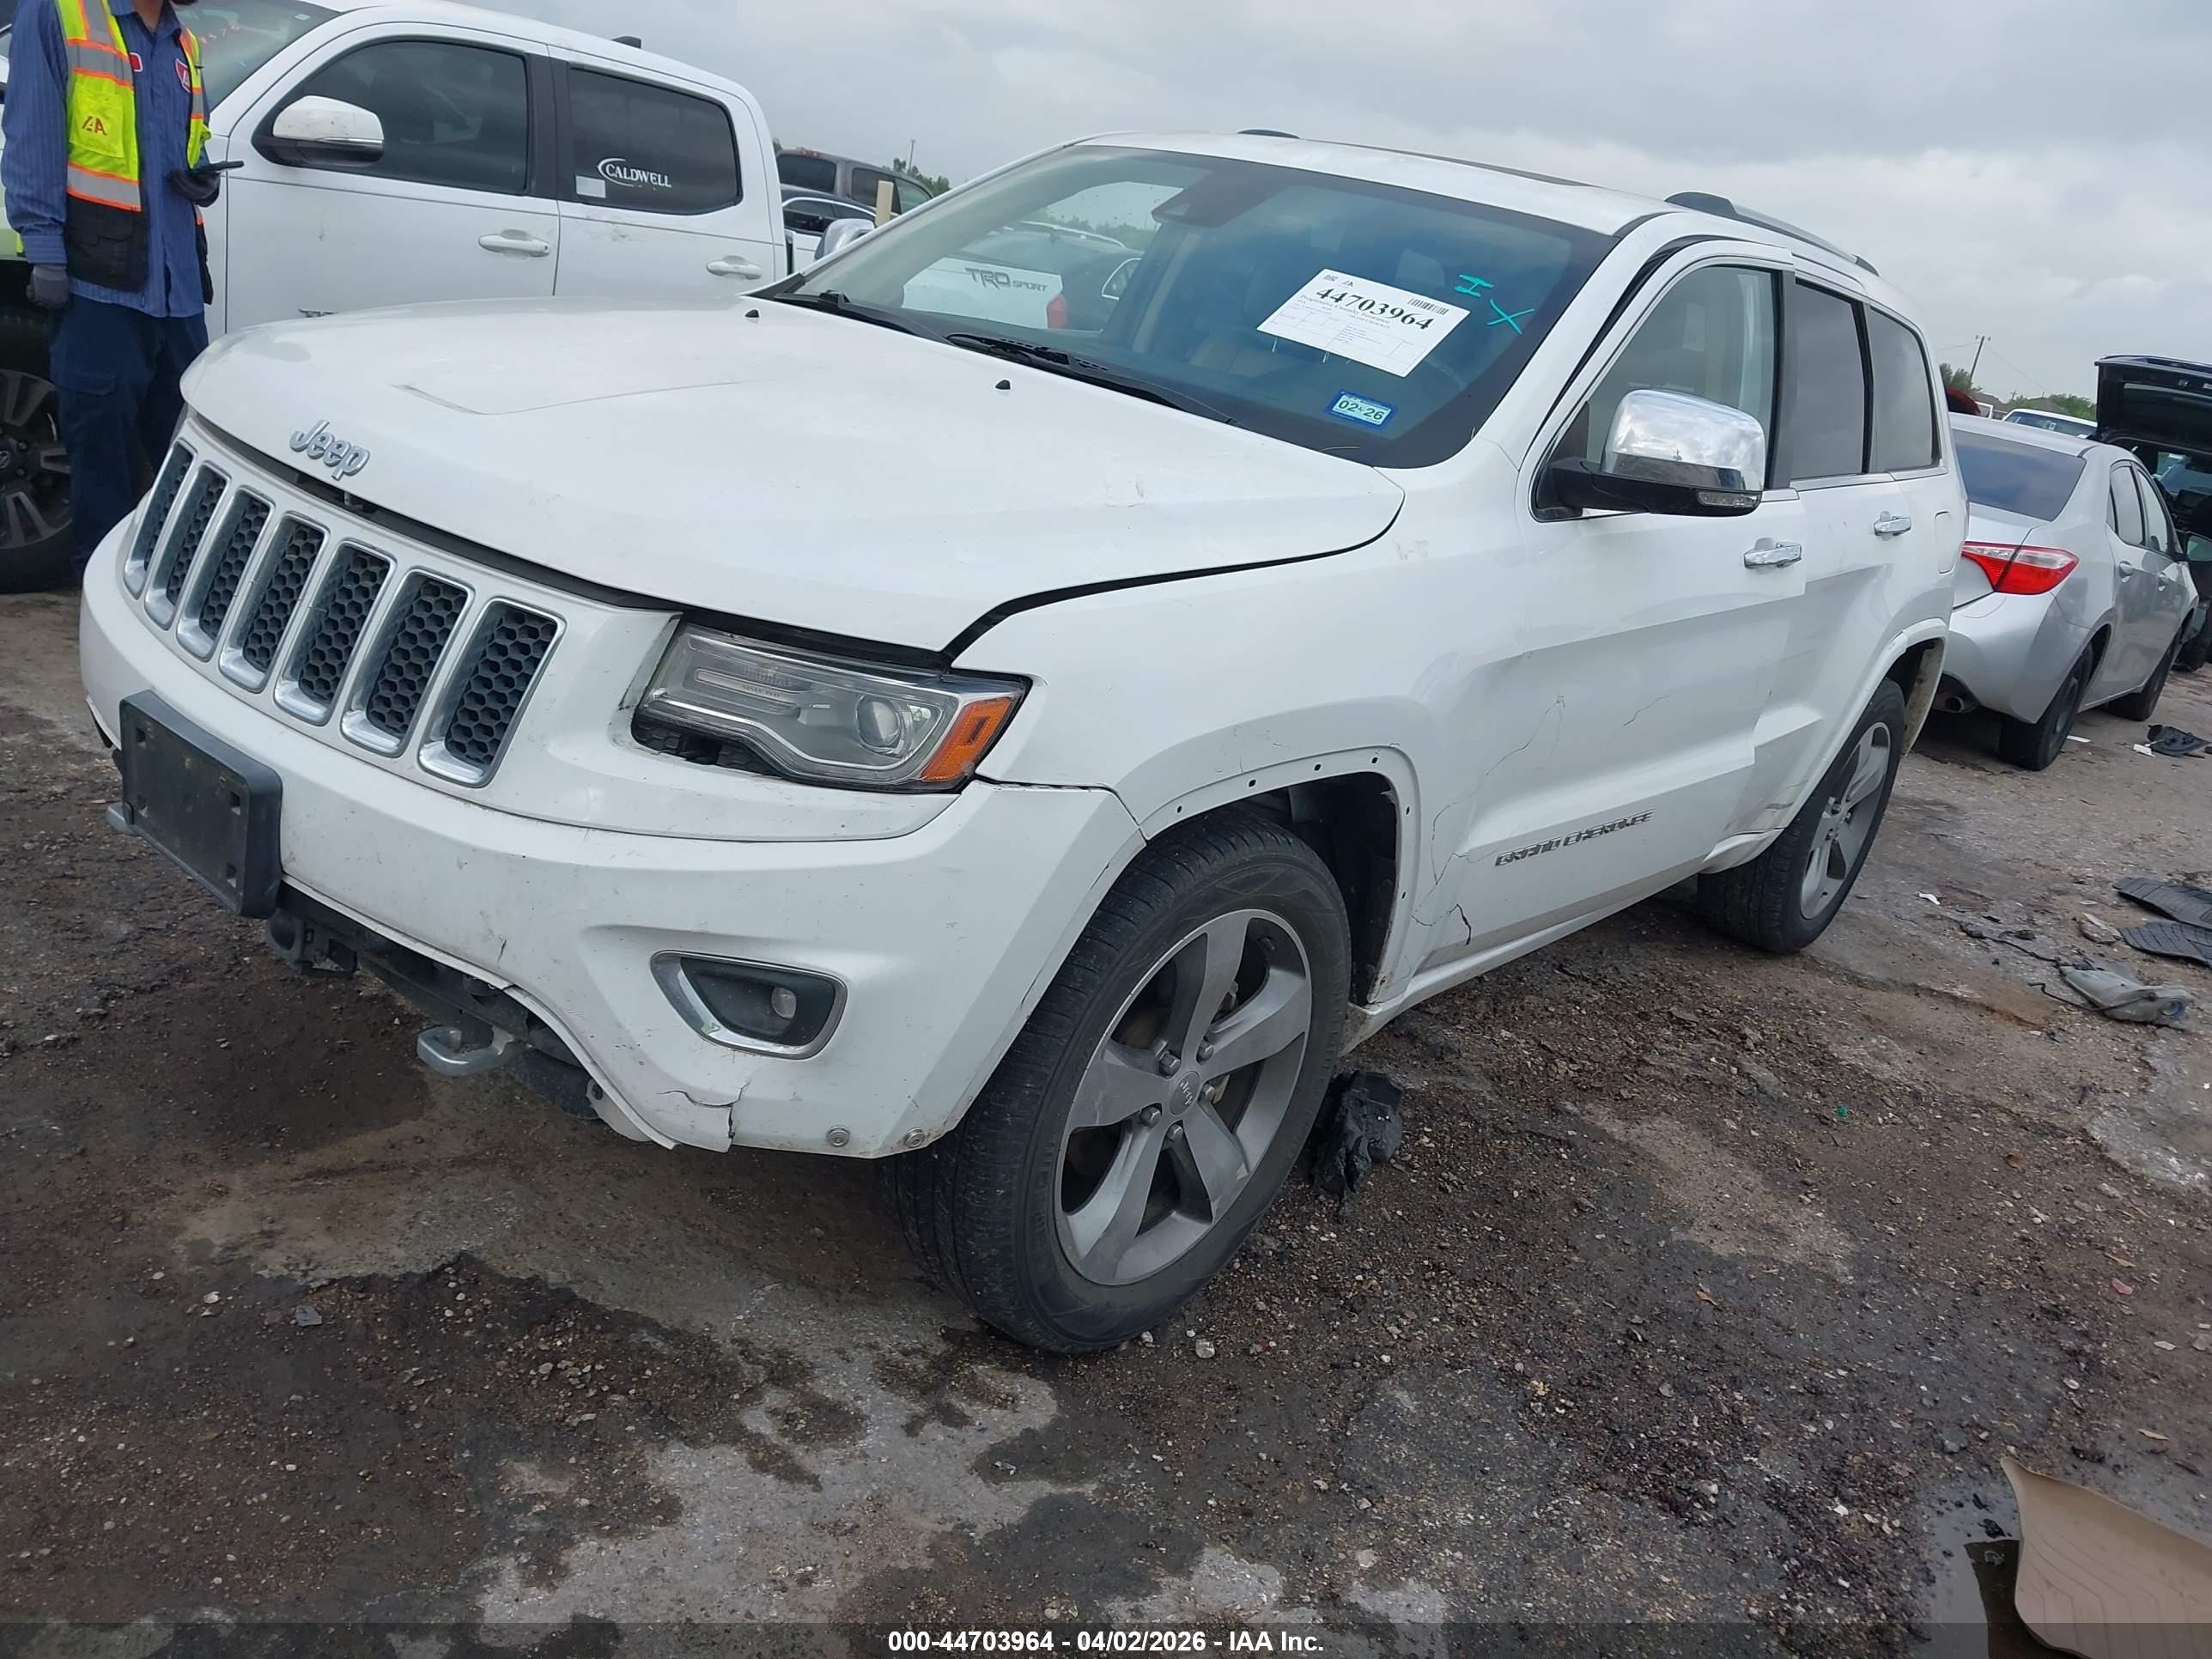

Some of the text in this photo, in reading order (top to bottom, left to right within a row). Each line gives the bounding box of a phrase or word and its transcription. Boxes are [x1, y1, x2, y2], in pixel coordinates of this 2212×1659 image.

[605, 163, 672, 188] CALDWELL
[964, 267, 1048, 292] TRD SPORT
[1316, 288, 1435, 331] 44703964
[289, 419, 370, 482] Jeep
[1494, 808, 1656, 866] GRAND CHEROKEE
